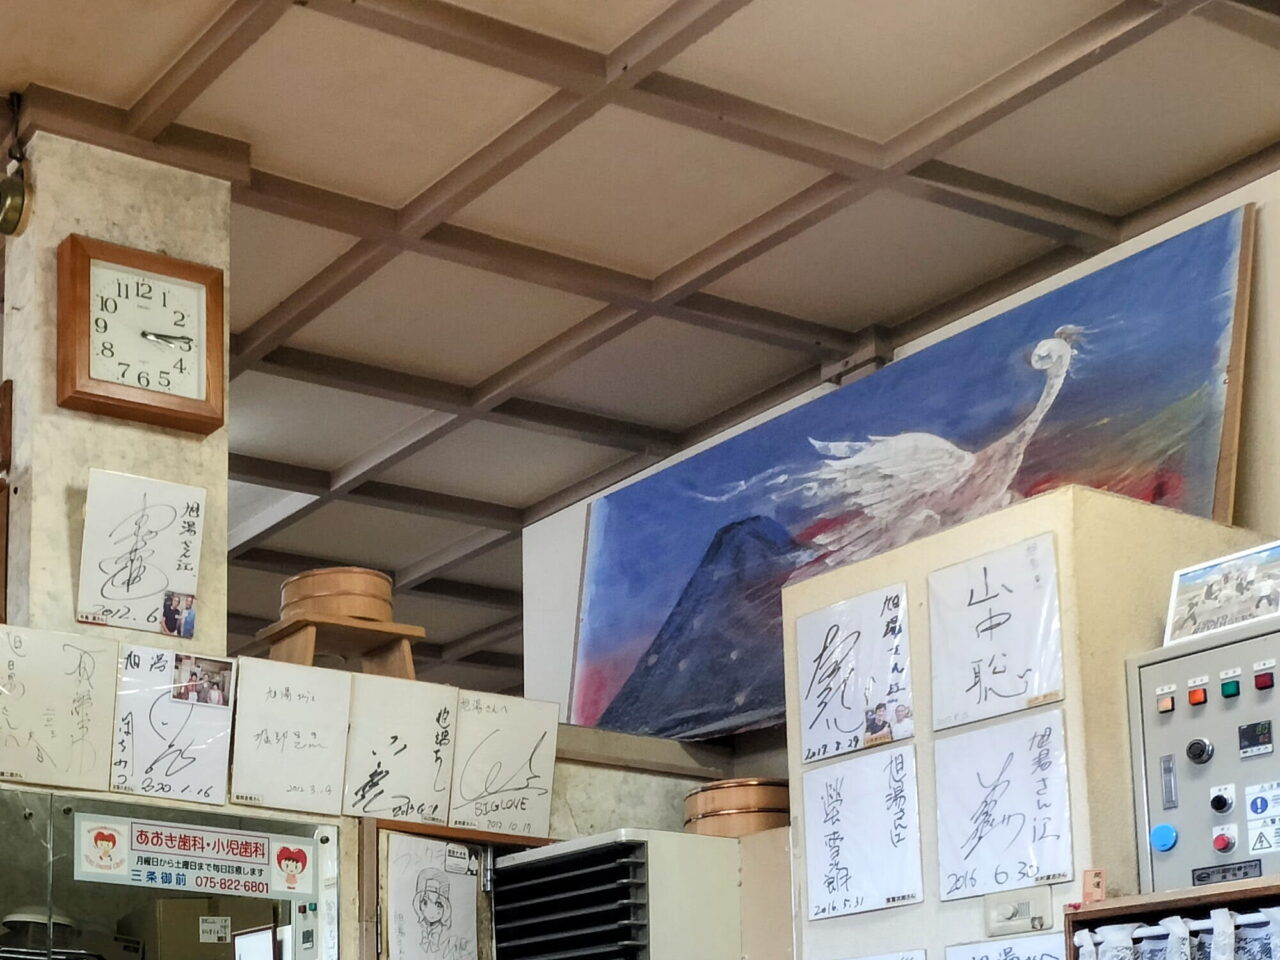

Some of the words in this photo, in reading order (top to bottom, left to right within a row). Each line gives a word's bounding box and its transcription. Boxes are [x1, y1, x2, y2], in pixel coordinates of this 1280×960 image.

[117, 281, 129, 299] 11
[136, 281, 153, 299] 12
[100, 296, 118, 314] 10
[162, 292, 167, 307] 1
[95, 317, 108, 333] 9
[173, 311, 186, 327] 2
[101, 342, 115, 358] 8
[117, 362, 130, 378] 7
[173, 358, 187, 374] 4
[137, 372, 150, 387] 6
[158, 371, 171, 387] 5
[136, 829, 266, 859] あおき歯科・小児歯科
[136, 857, 265, 877] 月曜日から土曜日まで毎日診療します
[130, 869, 187, 886] 三条御前
[195, 876, 270, 894] 075-822-6801
